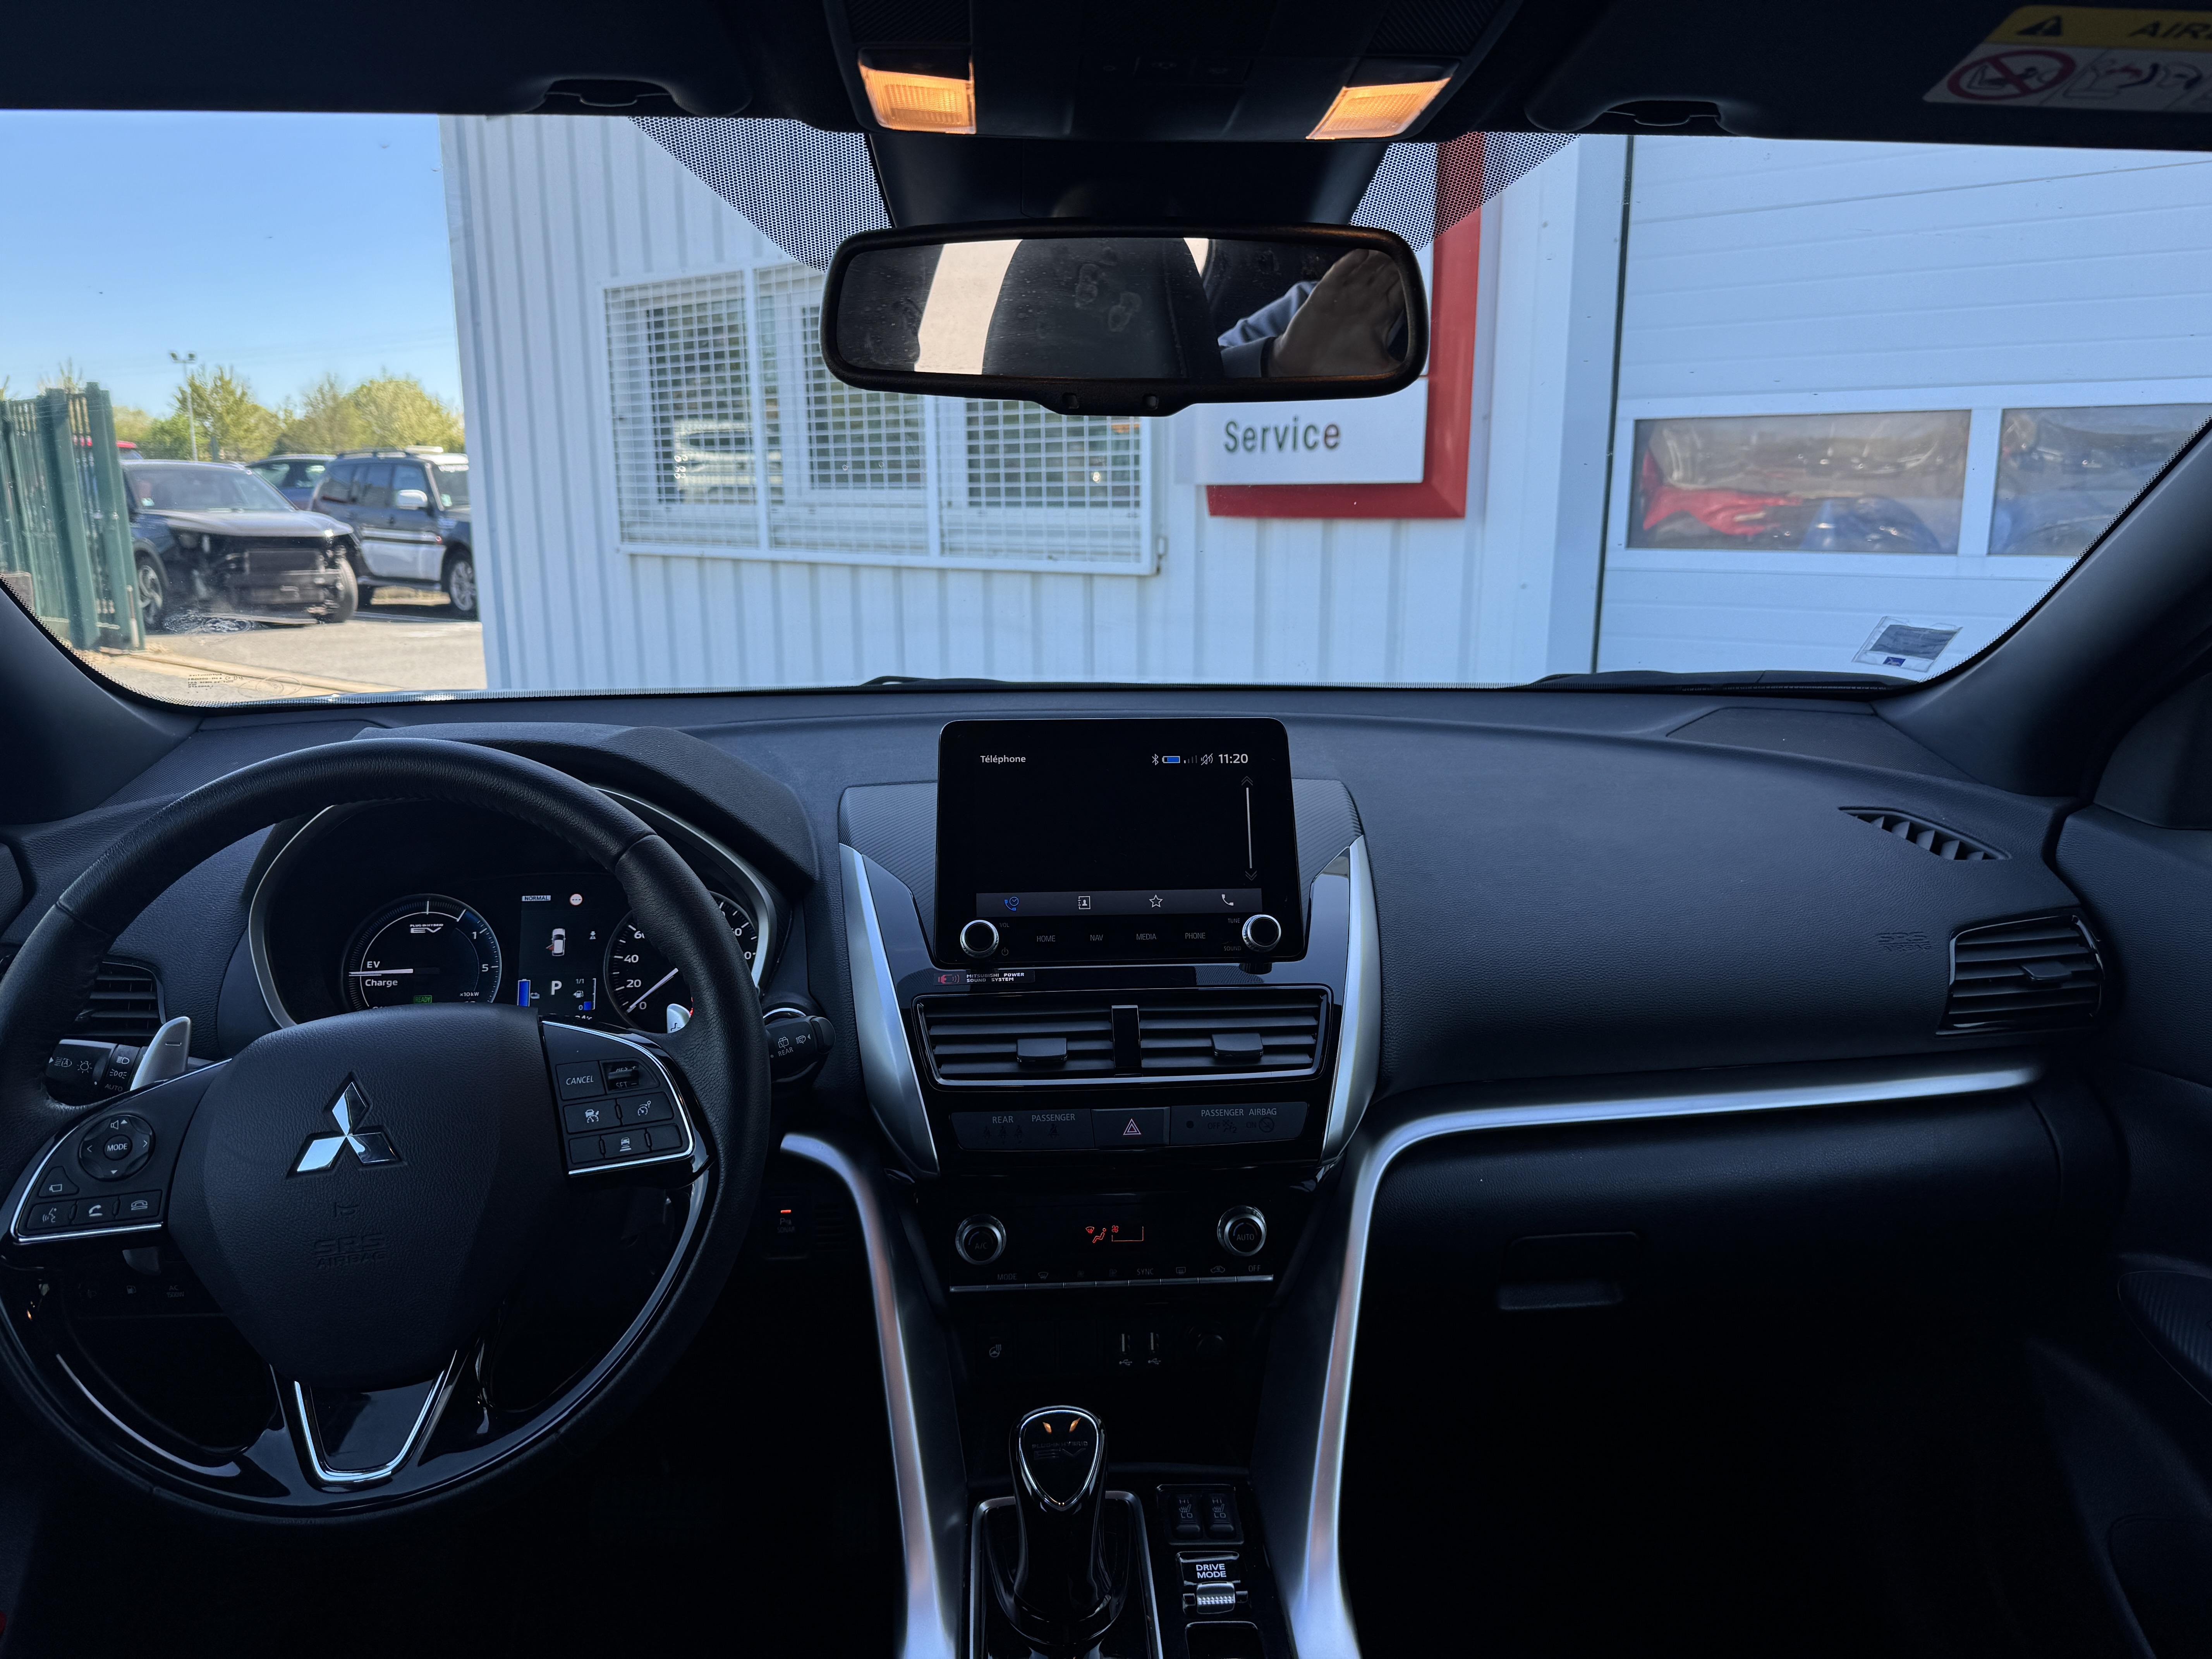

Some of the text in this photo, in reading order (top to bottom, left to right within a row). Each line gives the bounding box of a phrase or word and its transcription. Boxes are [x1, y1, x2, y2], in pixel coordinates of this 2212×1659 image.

[2130, 21, 2212, 39] AIR
[1224, 415, 1341, 453] Service
[980, 755, 1026, 764] Téléphone
[1218, 754, 1248, 764] 11:20
[623, 955, 639, 963] 40
[482, 964, 489, 972] 5
[365, 979, 398, 988] Charge
[551, 981, 562, 995] P
[626, 979, 641, 988] 20
[639, 1001, 647, 1010] 0
[778, 1047, 794, 1056] REAR
[566, 1075, 594, 1085] CANCEL
[105, 1084, 123, 1092] AUTO
[1201, 1109, 1244, 1117] PASSENGER
[992, 1113, 1076, 1124] REAR PASSENGER
[107, 1143, 128, 1151] MODE
